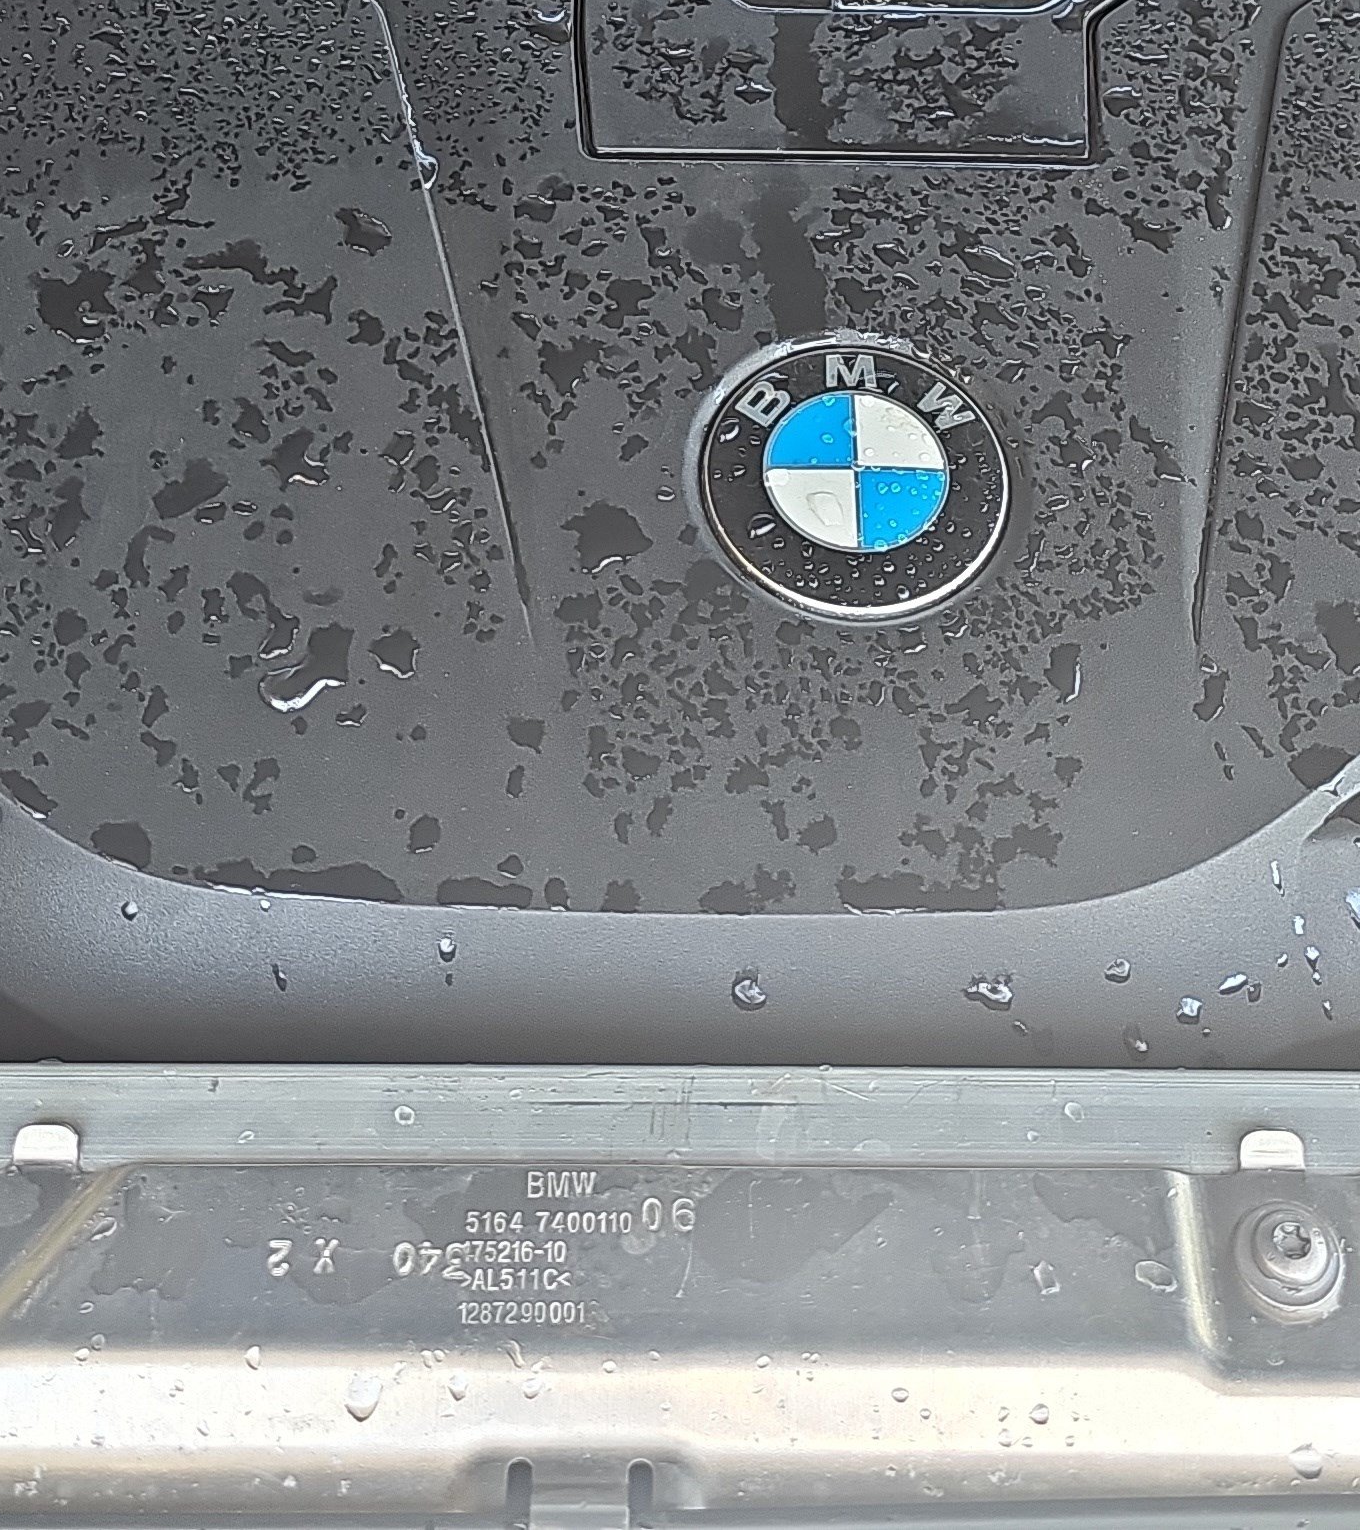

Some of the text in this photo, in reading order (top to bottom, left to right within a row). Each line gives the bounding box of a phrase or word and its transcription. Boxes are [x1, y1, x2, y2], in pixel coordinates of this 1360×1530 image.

[735, 354, 976, 433] BMW
[527, 1171, 597, 1198] BMW
[465, 1211, 632, 1234] 5164 7400110
[642, 1197, 696, 1232] 06
[457, 1301, 586, 1325] 1287290001
